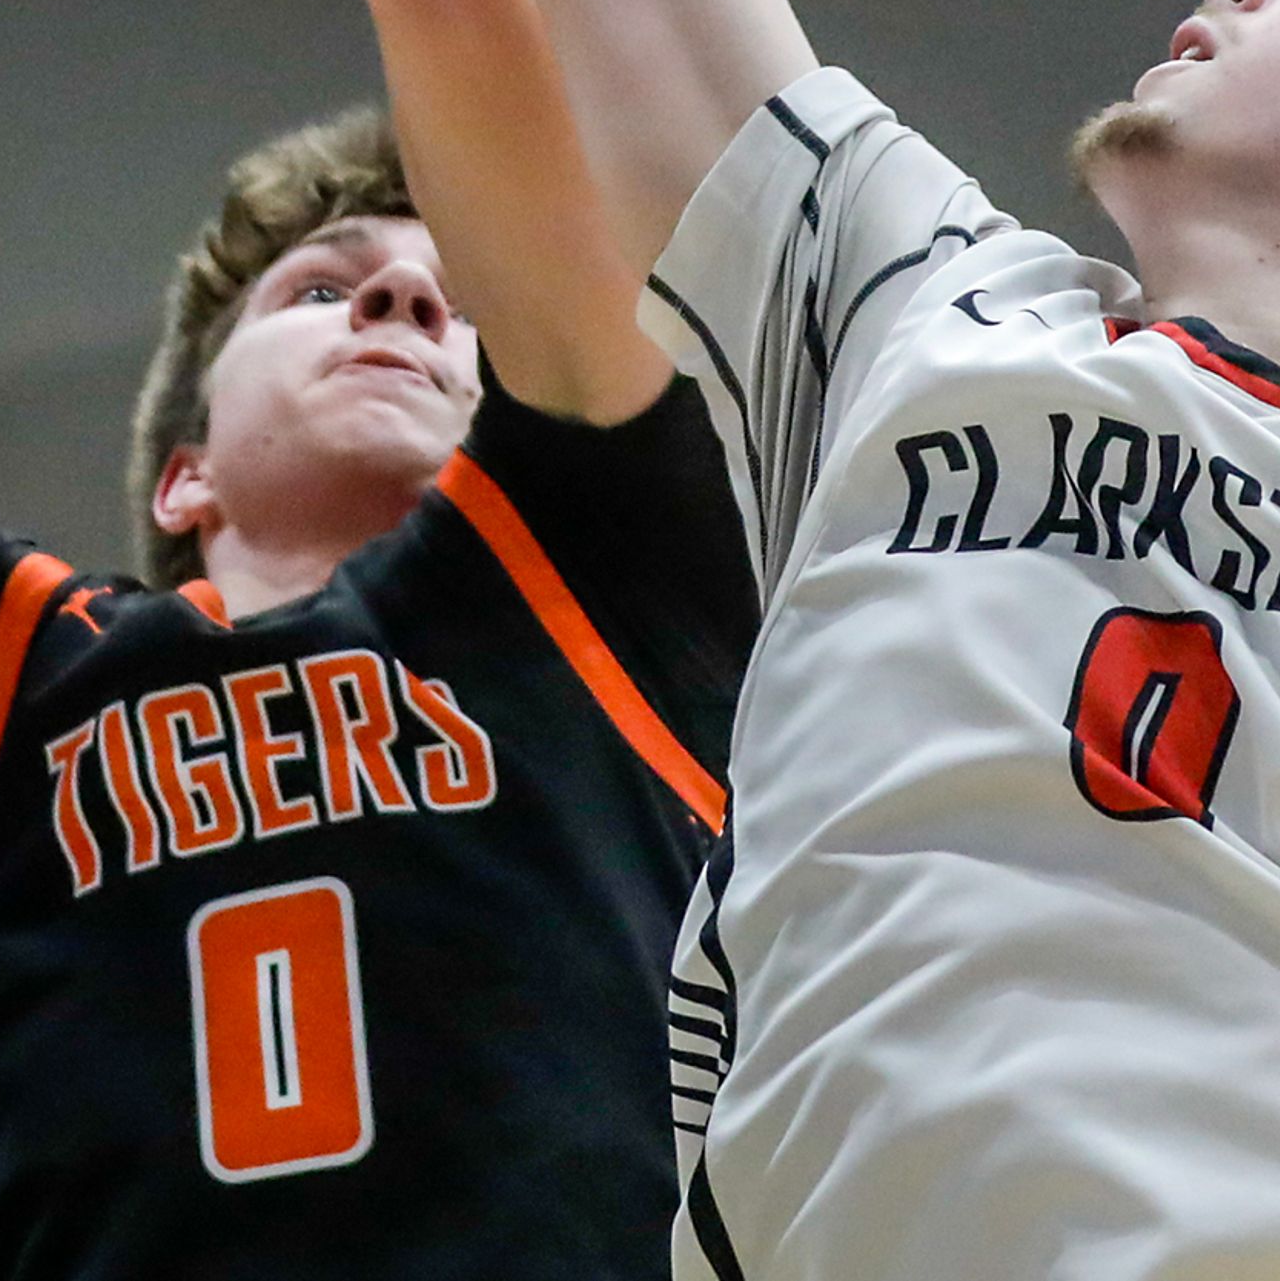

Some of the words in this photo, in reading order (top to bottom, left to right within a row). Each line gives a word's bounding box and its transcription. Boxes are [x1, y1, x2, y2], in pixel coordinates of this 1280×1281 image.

[45, 649, 497, 898] TIGERS
[1063, 606, 1242, 832] 0
[186, 875, 376, 1185] 0
